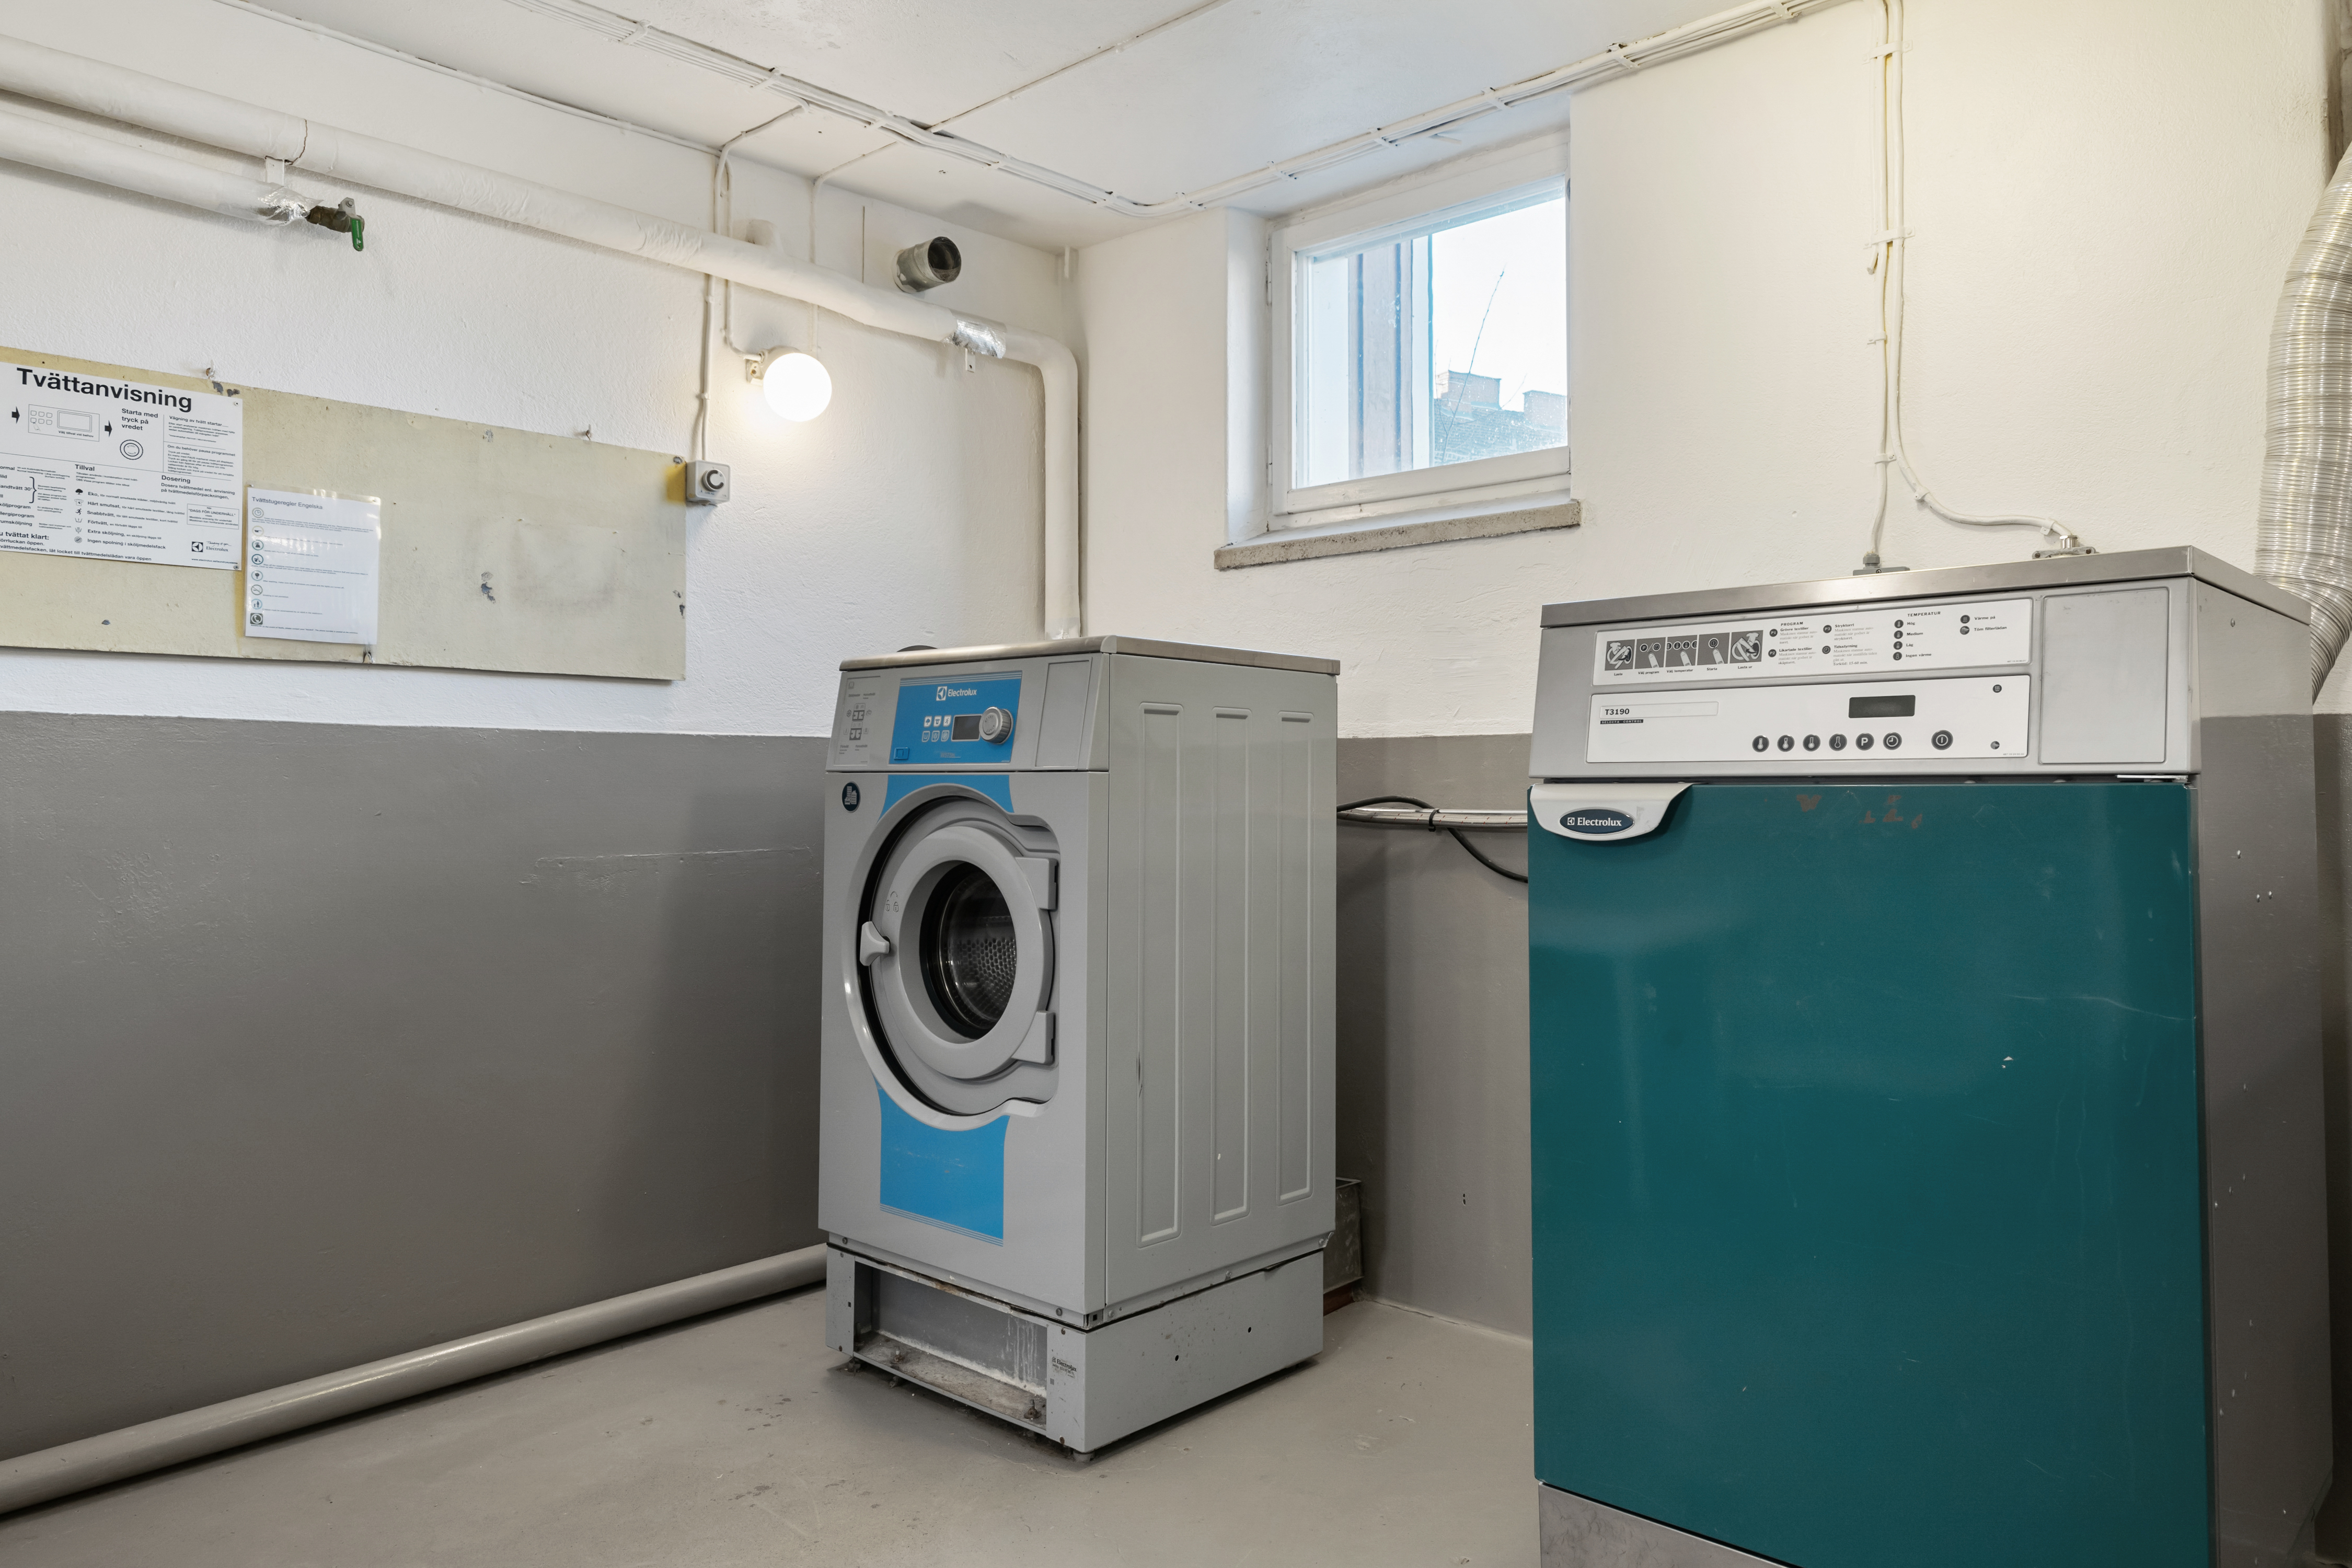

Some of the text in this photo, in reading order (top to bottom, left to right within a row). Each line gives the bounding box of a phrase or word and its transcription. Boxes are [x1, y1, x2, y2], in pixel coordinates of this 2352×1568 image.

[17, 367, 192, 412] Tvättanvisning
[162, 475, 190, 483] Dosering
[252, 497, 296, 506] Tvättstugeregler
[1577, 817, 1621, 826] Electrolux
[1057, 1359, 1077, 1371] Electrolux
